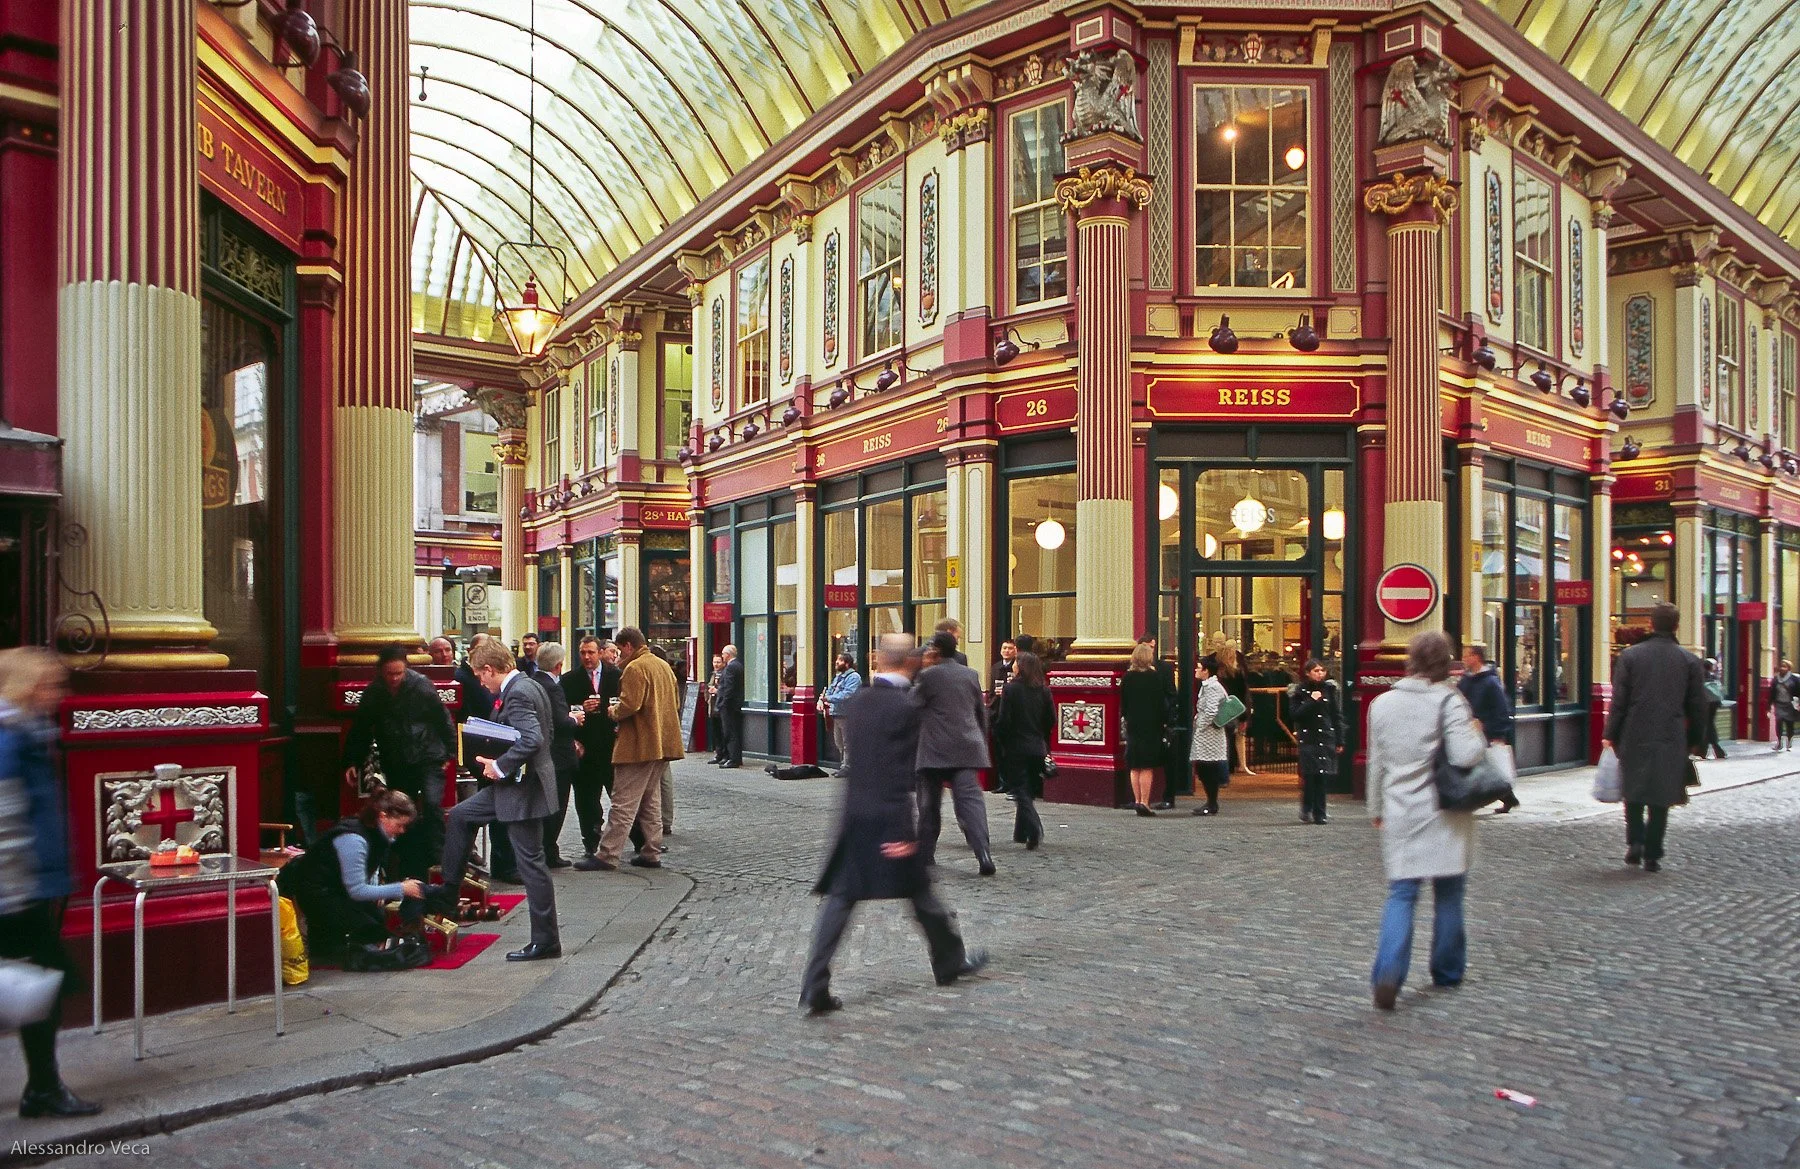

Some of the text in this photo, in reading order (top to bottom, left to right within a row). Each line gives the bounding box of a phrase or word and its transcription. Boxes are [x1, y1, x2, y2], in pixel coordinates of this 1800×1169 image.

[221, 141, 286, 215] TAVERN
[1218, 388, 1291, 406] REISS
[1026, 399, 1048, 417] 26
[862, 433, 892, 454] REISS
[1525, 429, 1552, 449] REISS
[1654, 480, 1670, 491] 31
[1229, 507, 1276, 523] REISS
[828, 591, 856, 602] REISS
[1557, 587, 1588, 598] REISS
